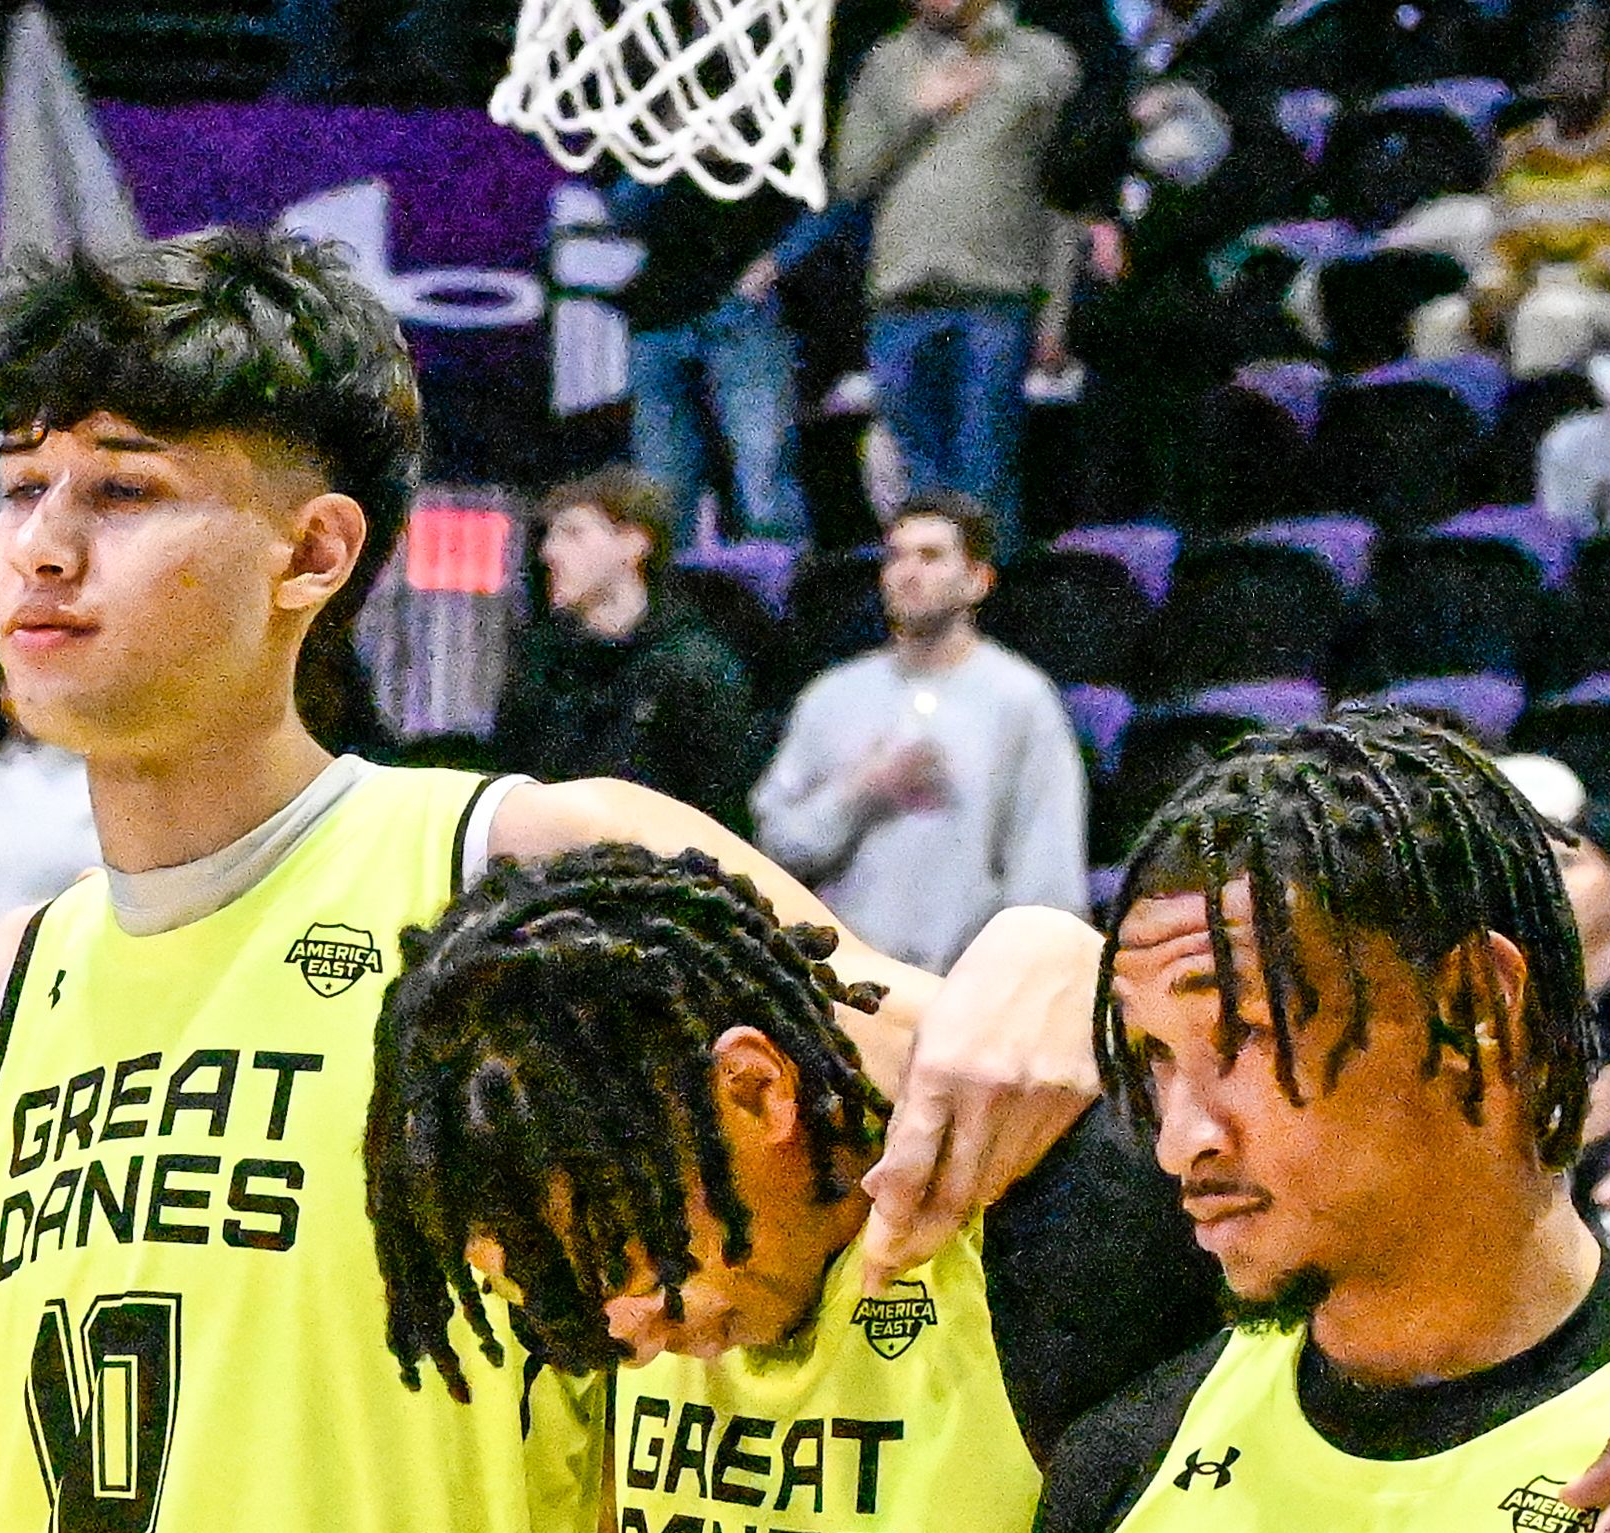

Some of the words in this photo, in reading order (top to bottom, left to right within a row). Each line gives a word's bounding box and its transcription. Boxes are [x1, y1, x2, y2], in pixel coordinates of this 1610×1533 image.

[284, 941, 382, 973] AMERICA
[306, 959, 359, 978] EAST
[9, 1049, 324, 1178] GREAT
[854, 1300, 936, 1324] AMERICA
[871, 1319, 915, 1336] EAST
[627, 1395, 904, 1515] GREAT
